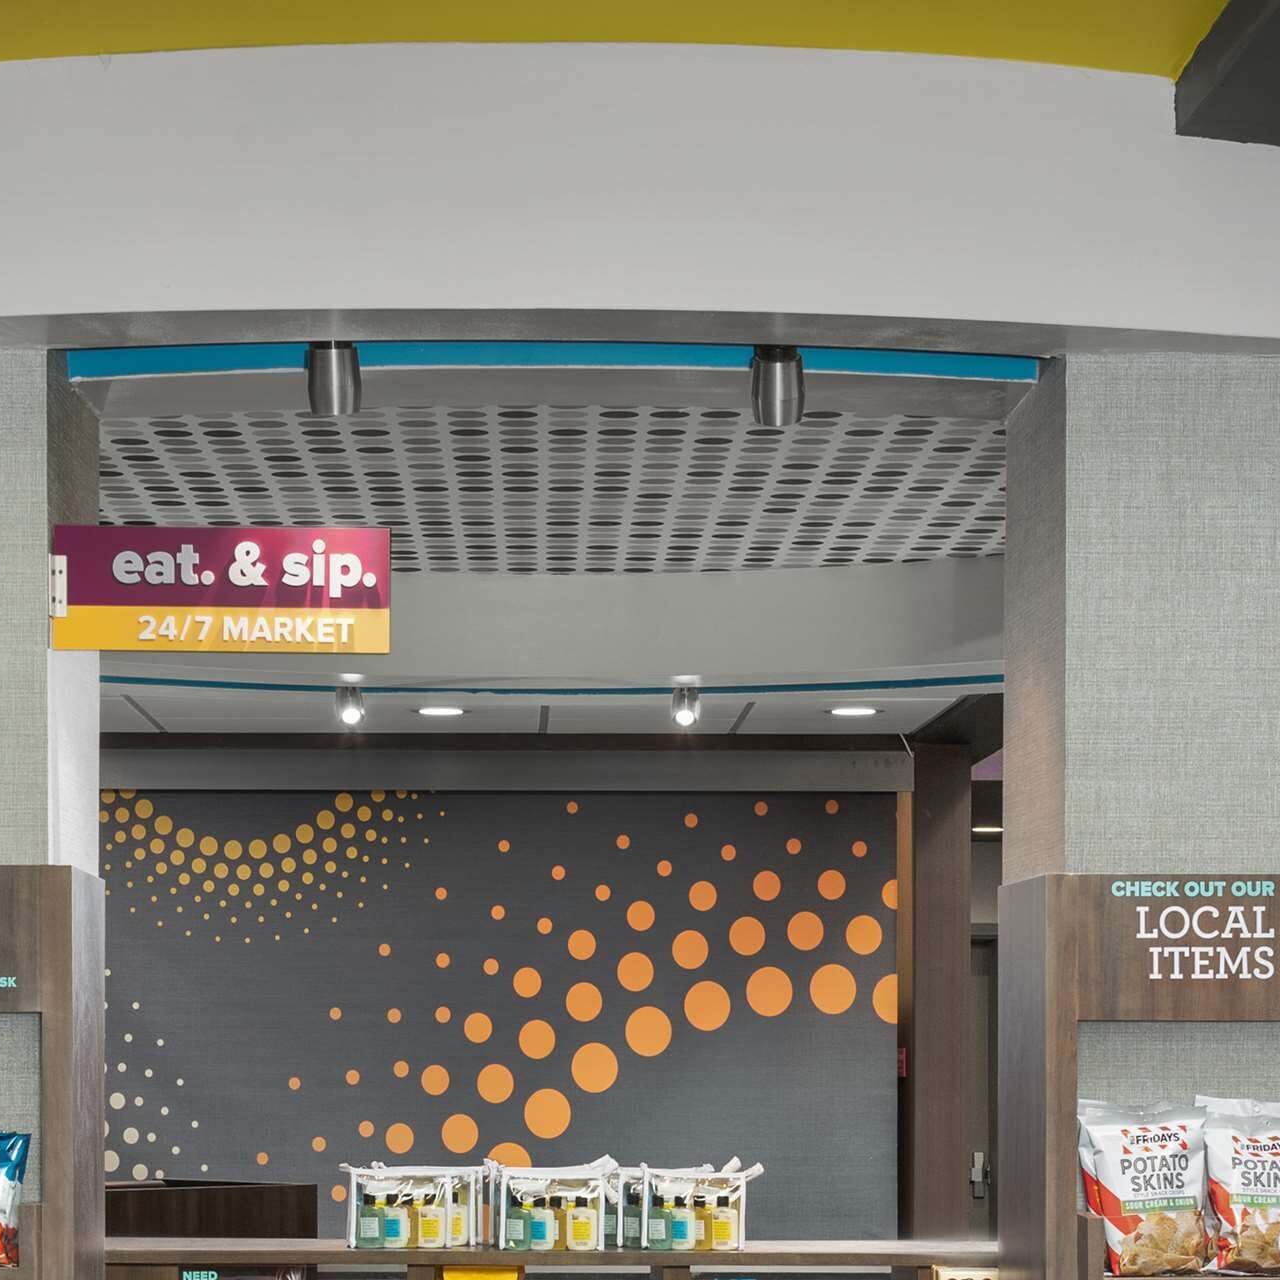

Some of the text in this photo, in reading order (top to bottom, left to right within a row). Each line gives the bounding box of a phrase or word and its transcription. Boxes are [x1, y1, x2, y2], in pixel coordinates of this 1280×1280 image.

[112, 538, 377, 598] eat. & sip.
[137, 615, 355, 644] 24/7 MARKET
[1111, 881, 1275, 897] CHECK OUT OUR
[1136, 905, 1275, 939] LOCAL
[1149, 946, 1275, 980] ITEMS
[1136, 1133, 1180, 1144] FRIDAYS
[1120, 1154, 1189, 1175] POTATO
[1130, 1172, 1185, 1192] SKINS
[183, 1271, 218, 1280] NEED
